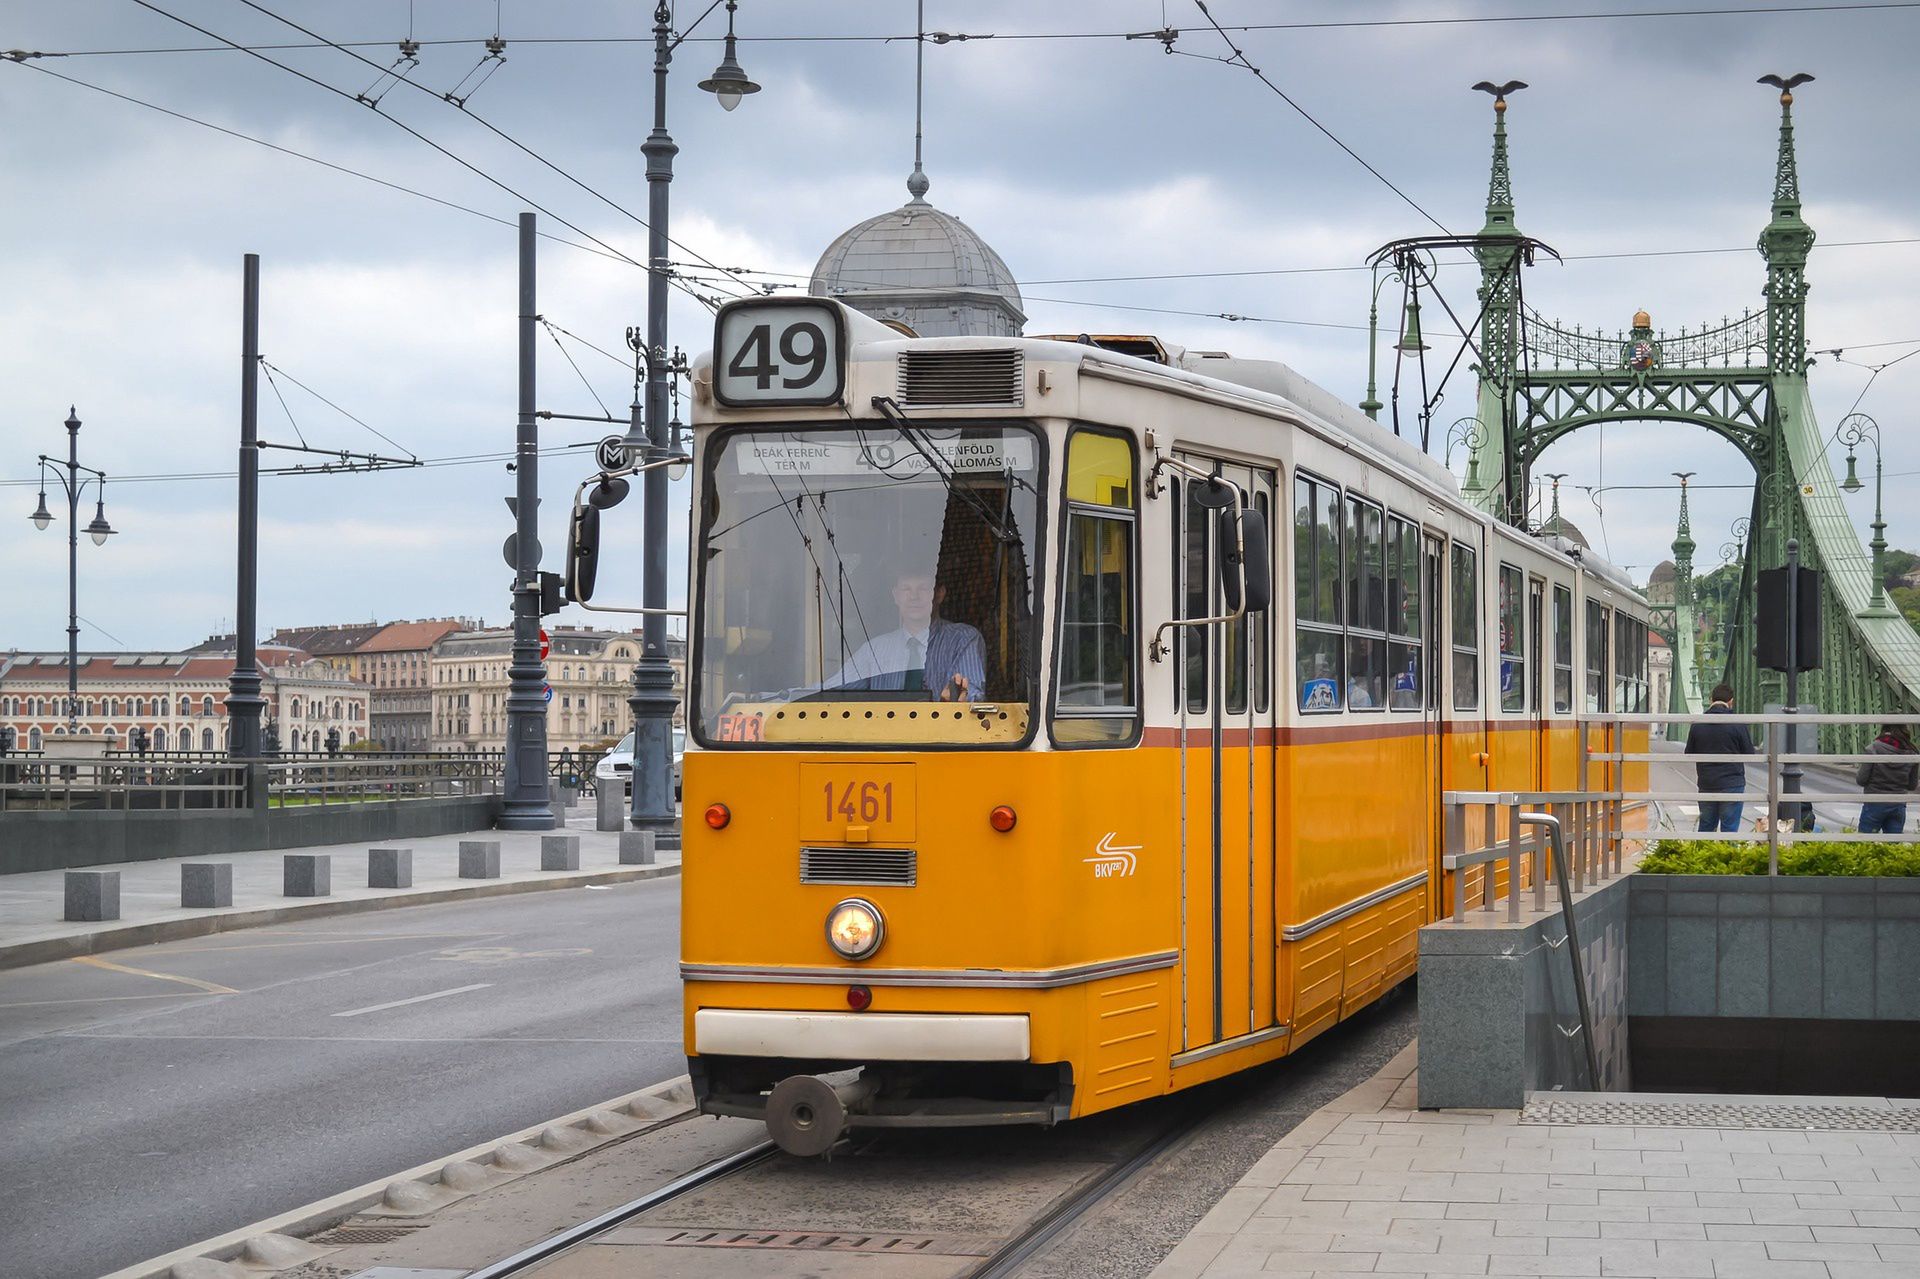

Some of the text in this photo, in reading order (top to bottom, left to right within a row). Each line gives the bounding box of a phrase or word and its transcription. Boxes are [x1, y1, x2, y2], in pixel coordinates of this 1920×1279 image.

[728, 321, 828, 390] 49
[753, 446, 831, 458] DEÁK FERENC
[855, 444, 895, 471] 49
[1005, 456, 1017, 466] M
[775, 458, 811, 471] TÉR M
[824, 781, 893, 823] 1461
